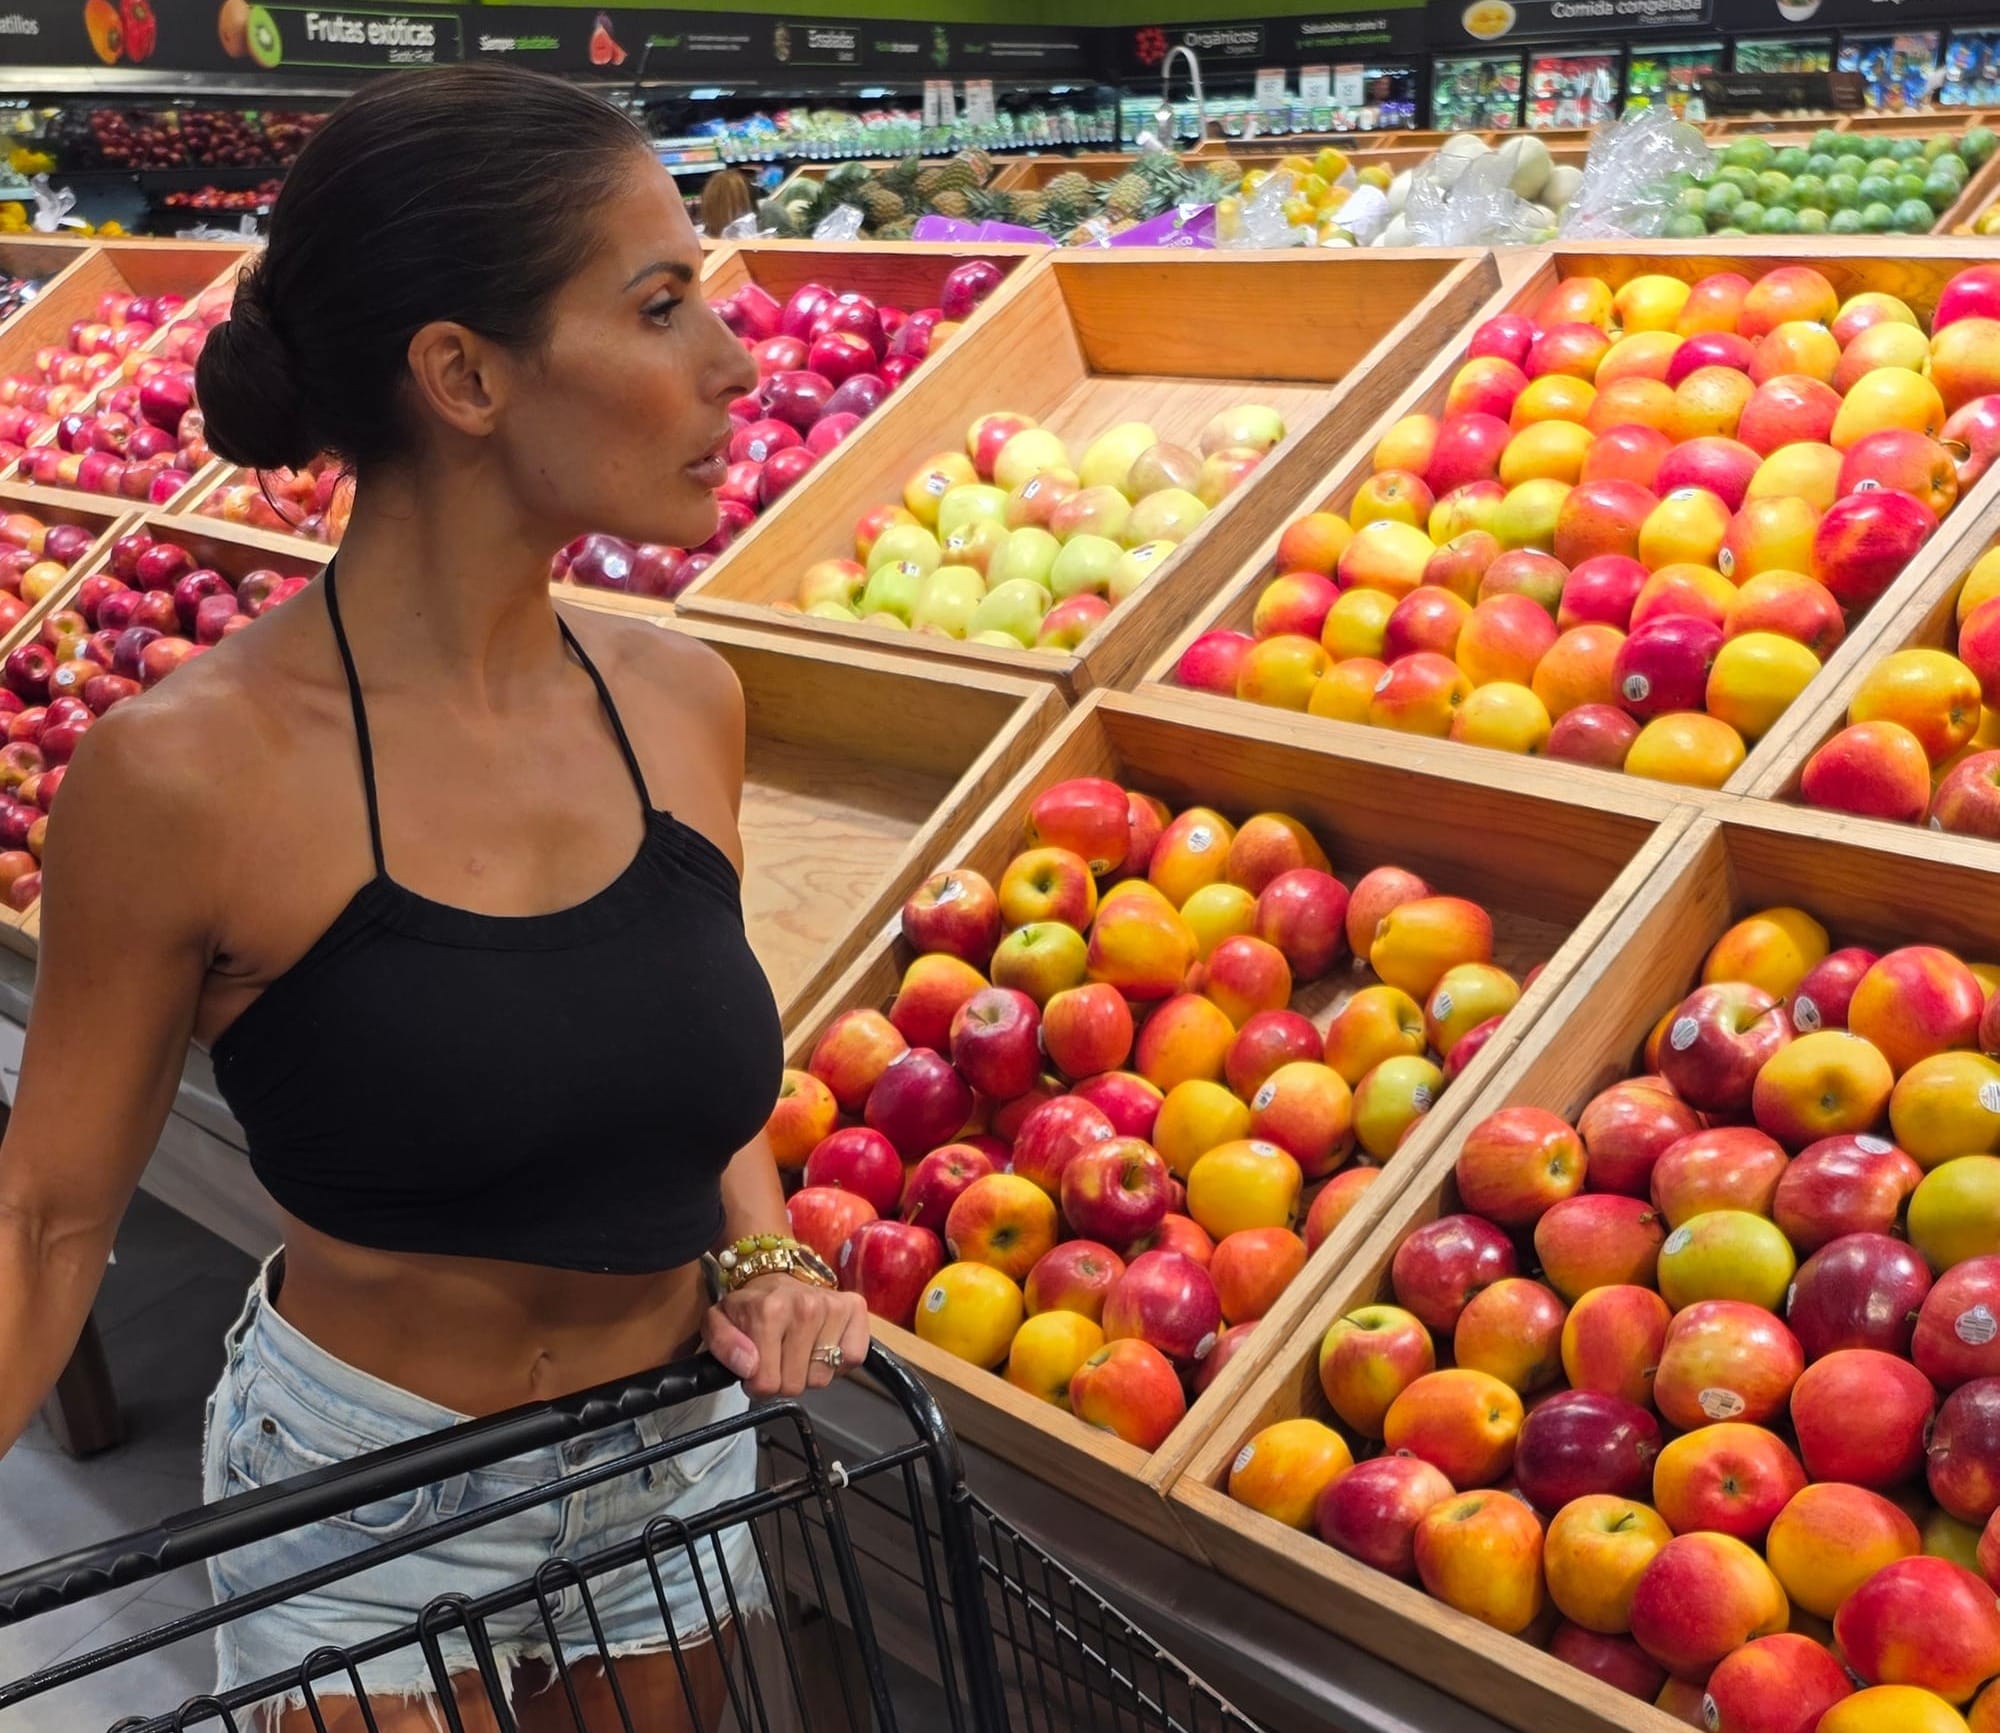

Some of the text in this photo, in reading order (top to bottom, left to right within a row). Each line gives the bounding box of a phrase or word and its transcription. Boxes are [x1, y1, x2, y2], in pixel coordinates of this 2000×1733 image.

[1551, 2, 1614, 18] Comida
[306, 12, 436, 46] Frutas exóticas
[1184, 31, 1259, 48] Orgánicos
